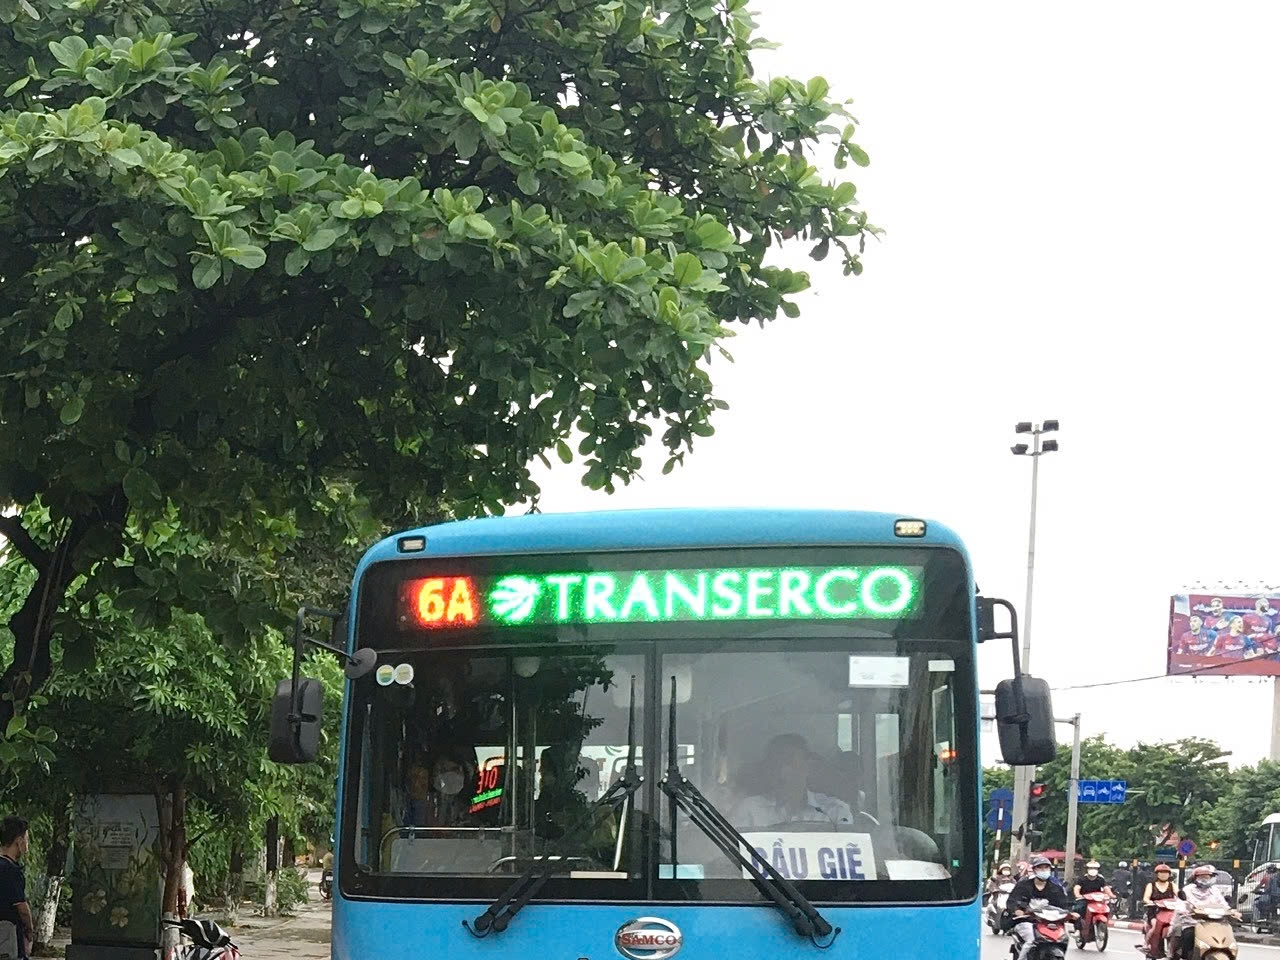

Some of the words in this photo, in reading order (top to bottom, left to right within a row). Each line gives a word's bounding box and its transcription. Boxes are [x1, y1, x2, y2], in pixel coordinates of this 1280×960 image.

[417, 577, 477, 625] 6A
[544, 565, 917, 622] TRANSERCO
[817, 842, 866, 881] GIẼ
[621, 932, 678, 946] SAMCO
